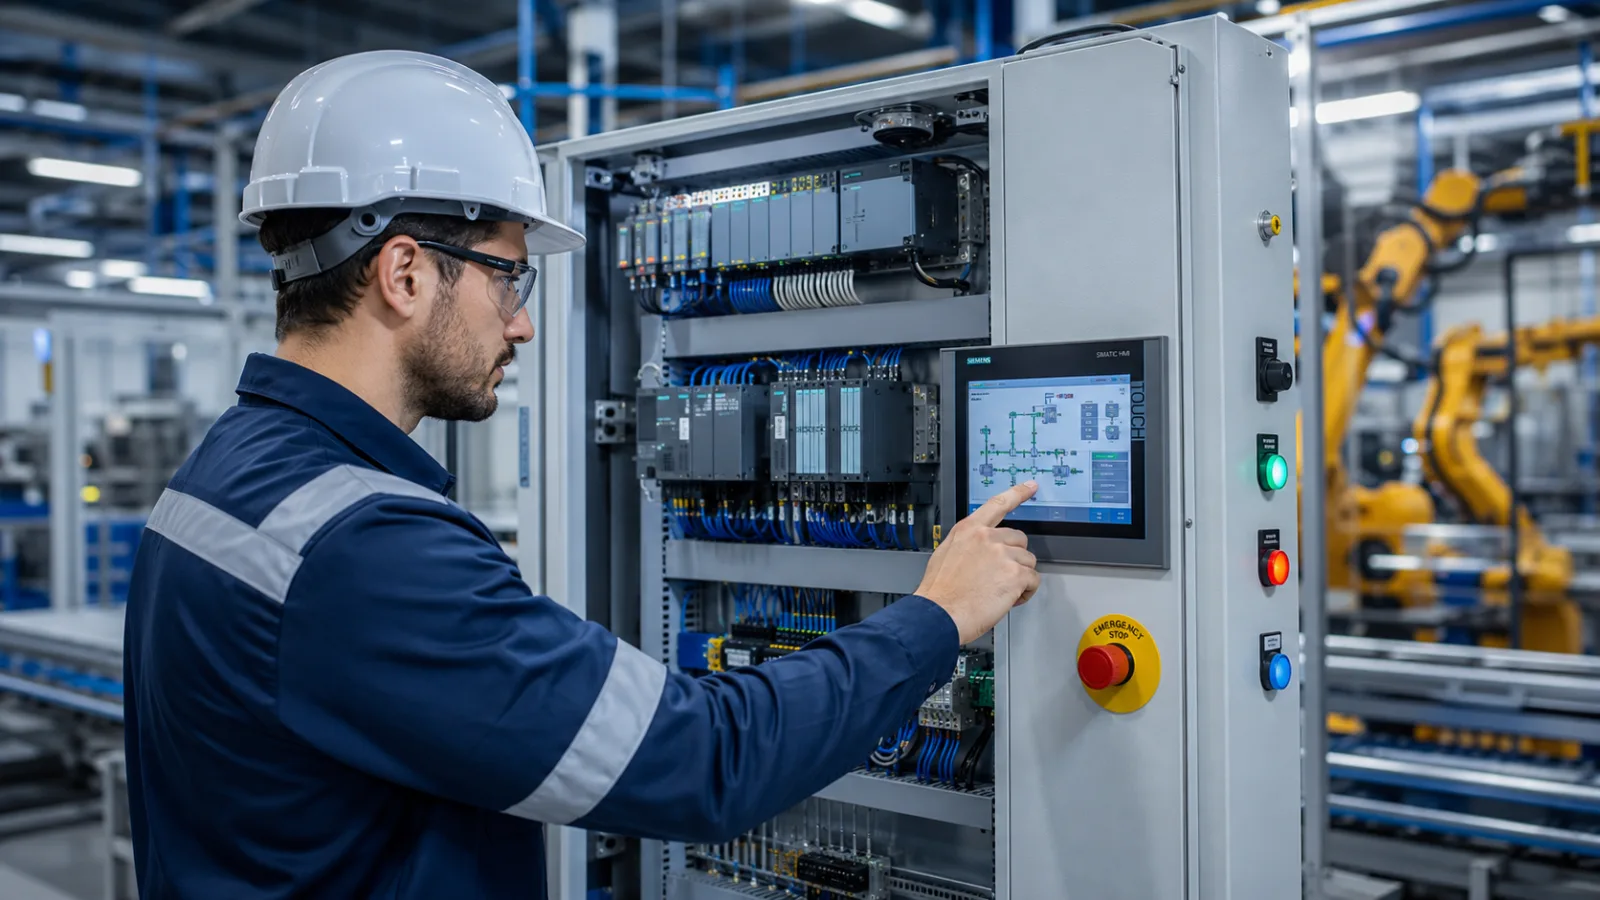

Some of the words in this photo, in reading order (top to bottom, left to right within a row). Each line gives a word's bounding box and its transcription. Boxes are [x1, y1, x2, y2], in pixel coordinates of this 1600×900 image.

[1096, 350, 1118, 359] SIMATIC
[967, 356, 991, 364] SIEMENS
[1131, 382, 1145, 439] TOUCH
[1093, 619, 1144, 640] EMERGENCY
[1108, 630, 1129, 639] STOP
